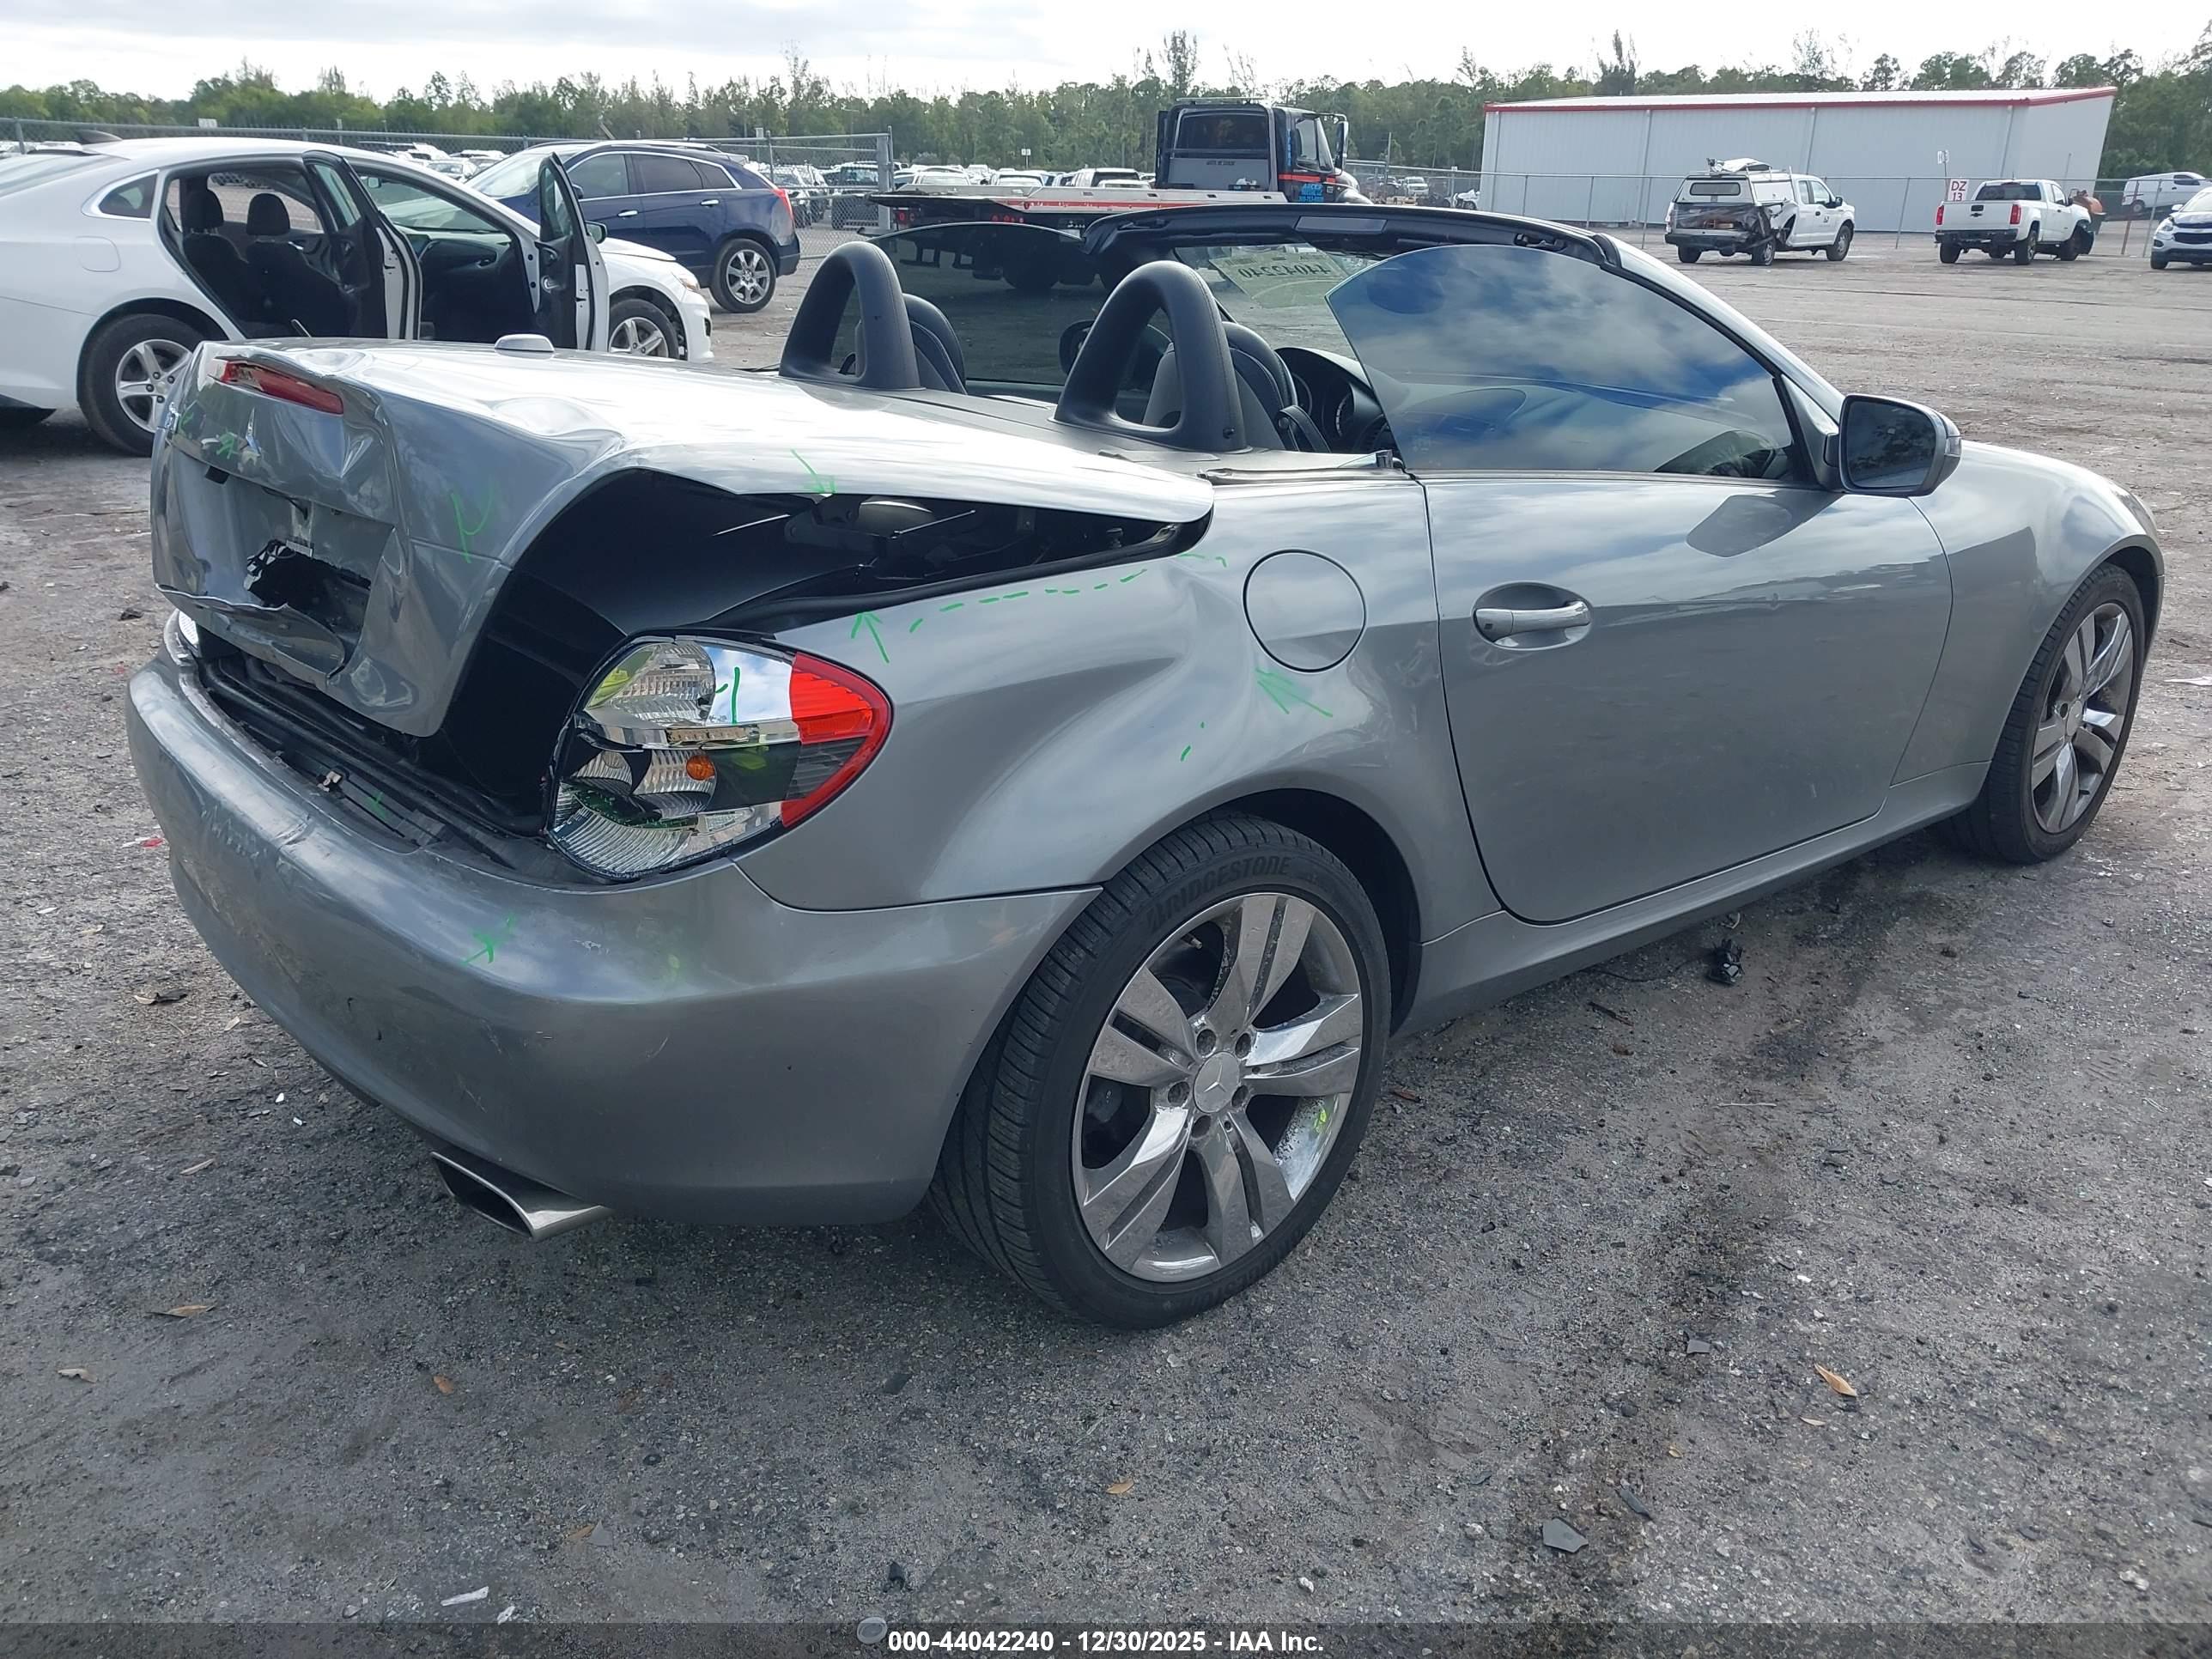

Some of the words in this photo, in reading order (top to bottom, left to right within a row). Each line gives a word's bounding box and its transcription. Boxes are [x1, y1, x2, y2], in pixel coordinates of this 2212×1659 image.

[1950, 181, 1967, 191] DZ
[1952, 191, 1963, 202] 13
[1145, 855, 1292, 933] BRIDGESTONE
